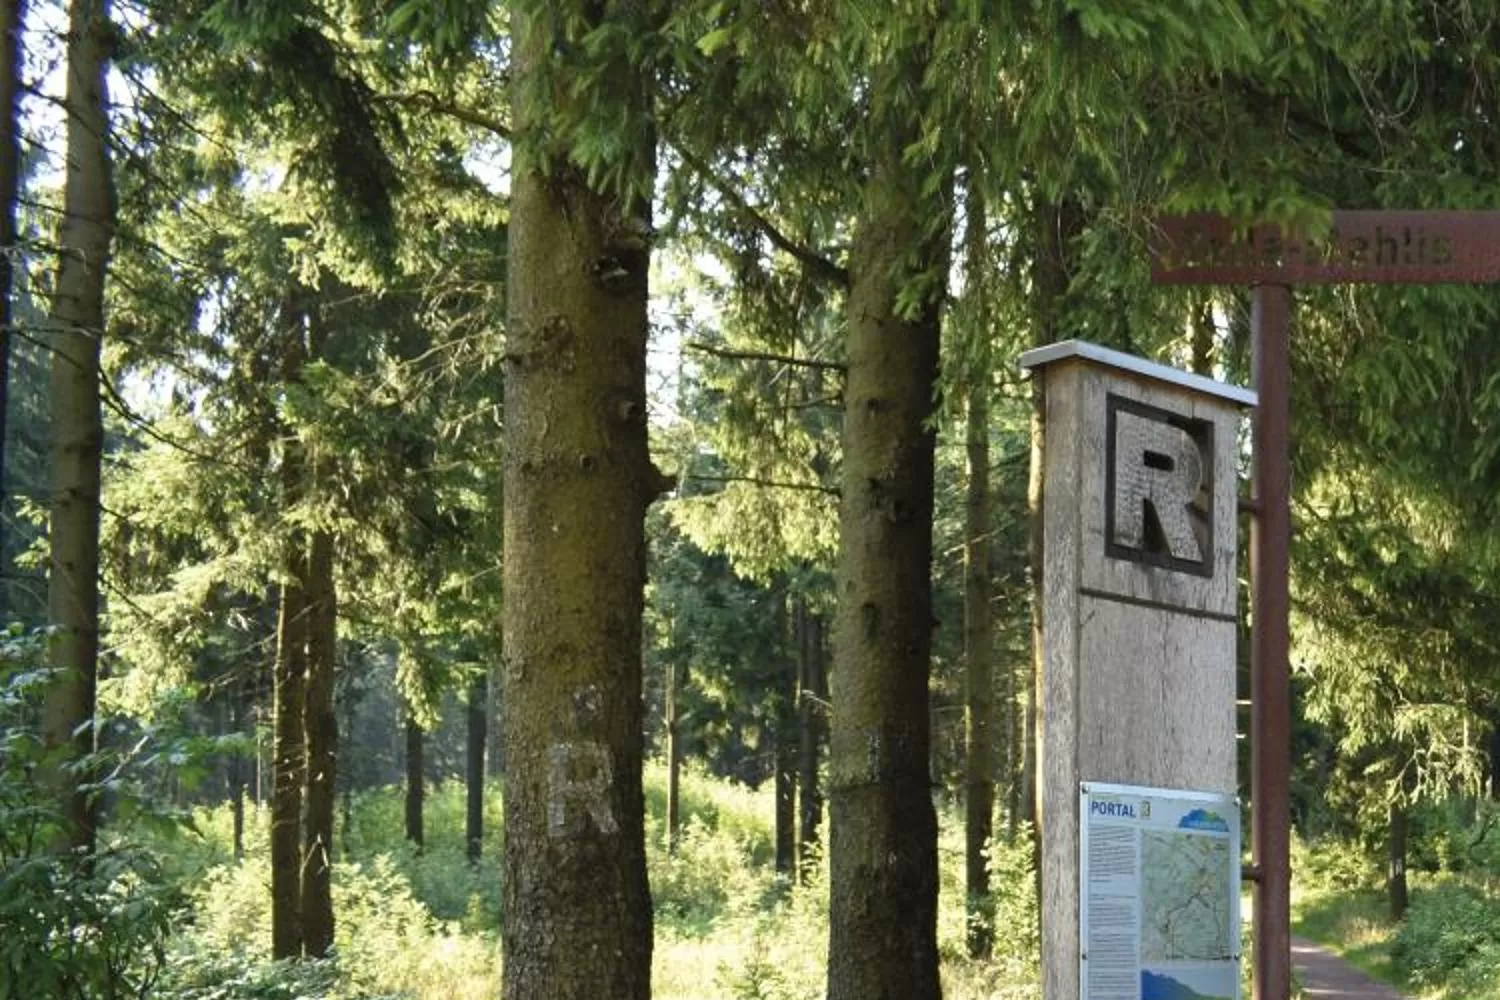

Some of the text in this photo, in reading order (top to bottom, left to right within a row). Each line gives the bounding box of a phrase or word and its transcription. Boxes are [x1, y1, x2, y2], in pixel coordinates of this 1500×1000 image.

[1112, 408, 1205, 564] R
[548, 742, 620, 837] R
[1091, 801, 1137, 818] PORTAL
